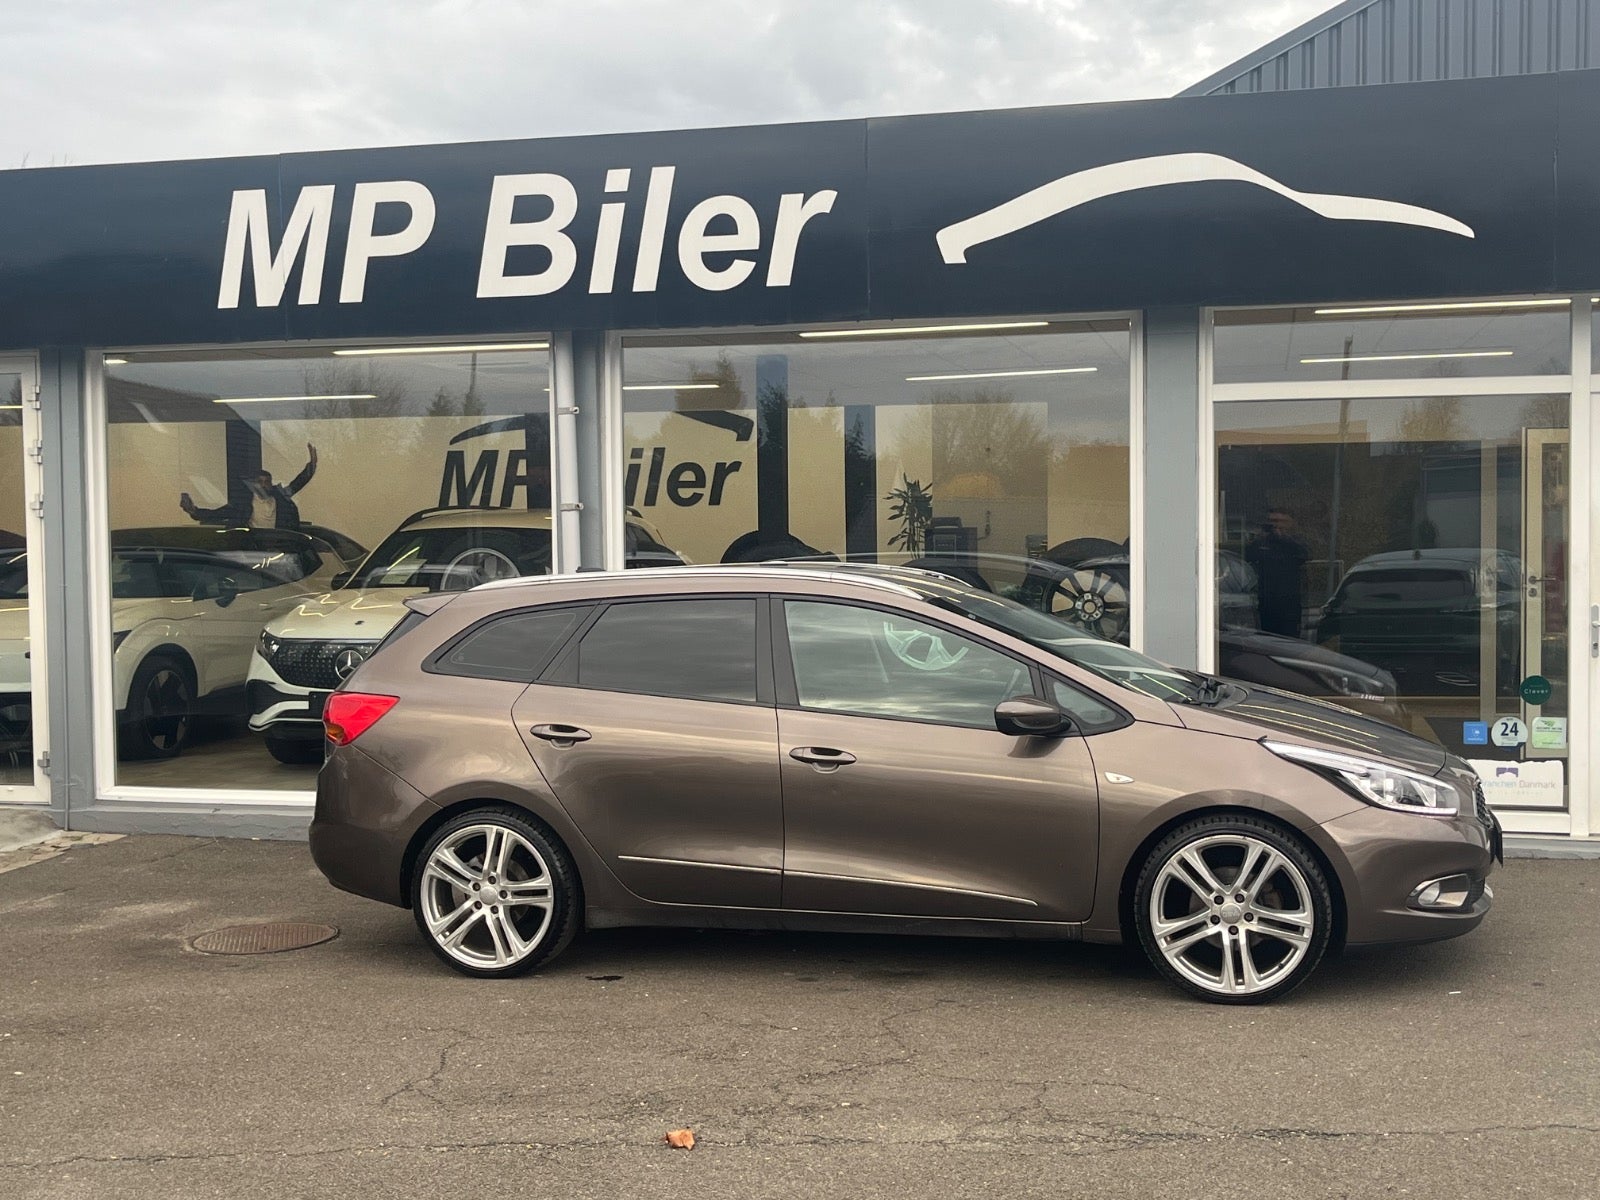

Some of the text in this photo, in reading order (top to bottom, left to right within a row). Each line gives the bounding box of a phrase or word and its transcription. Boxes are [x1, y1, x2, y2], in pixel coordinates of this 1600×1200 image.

[218, 166, 838, 309] MP Biler
[625, 447, 742, 507] iler
[1501, 722, 1519, 737] 24
[1519, 780, 1556, 789] Danmark
